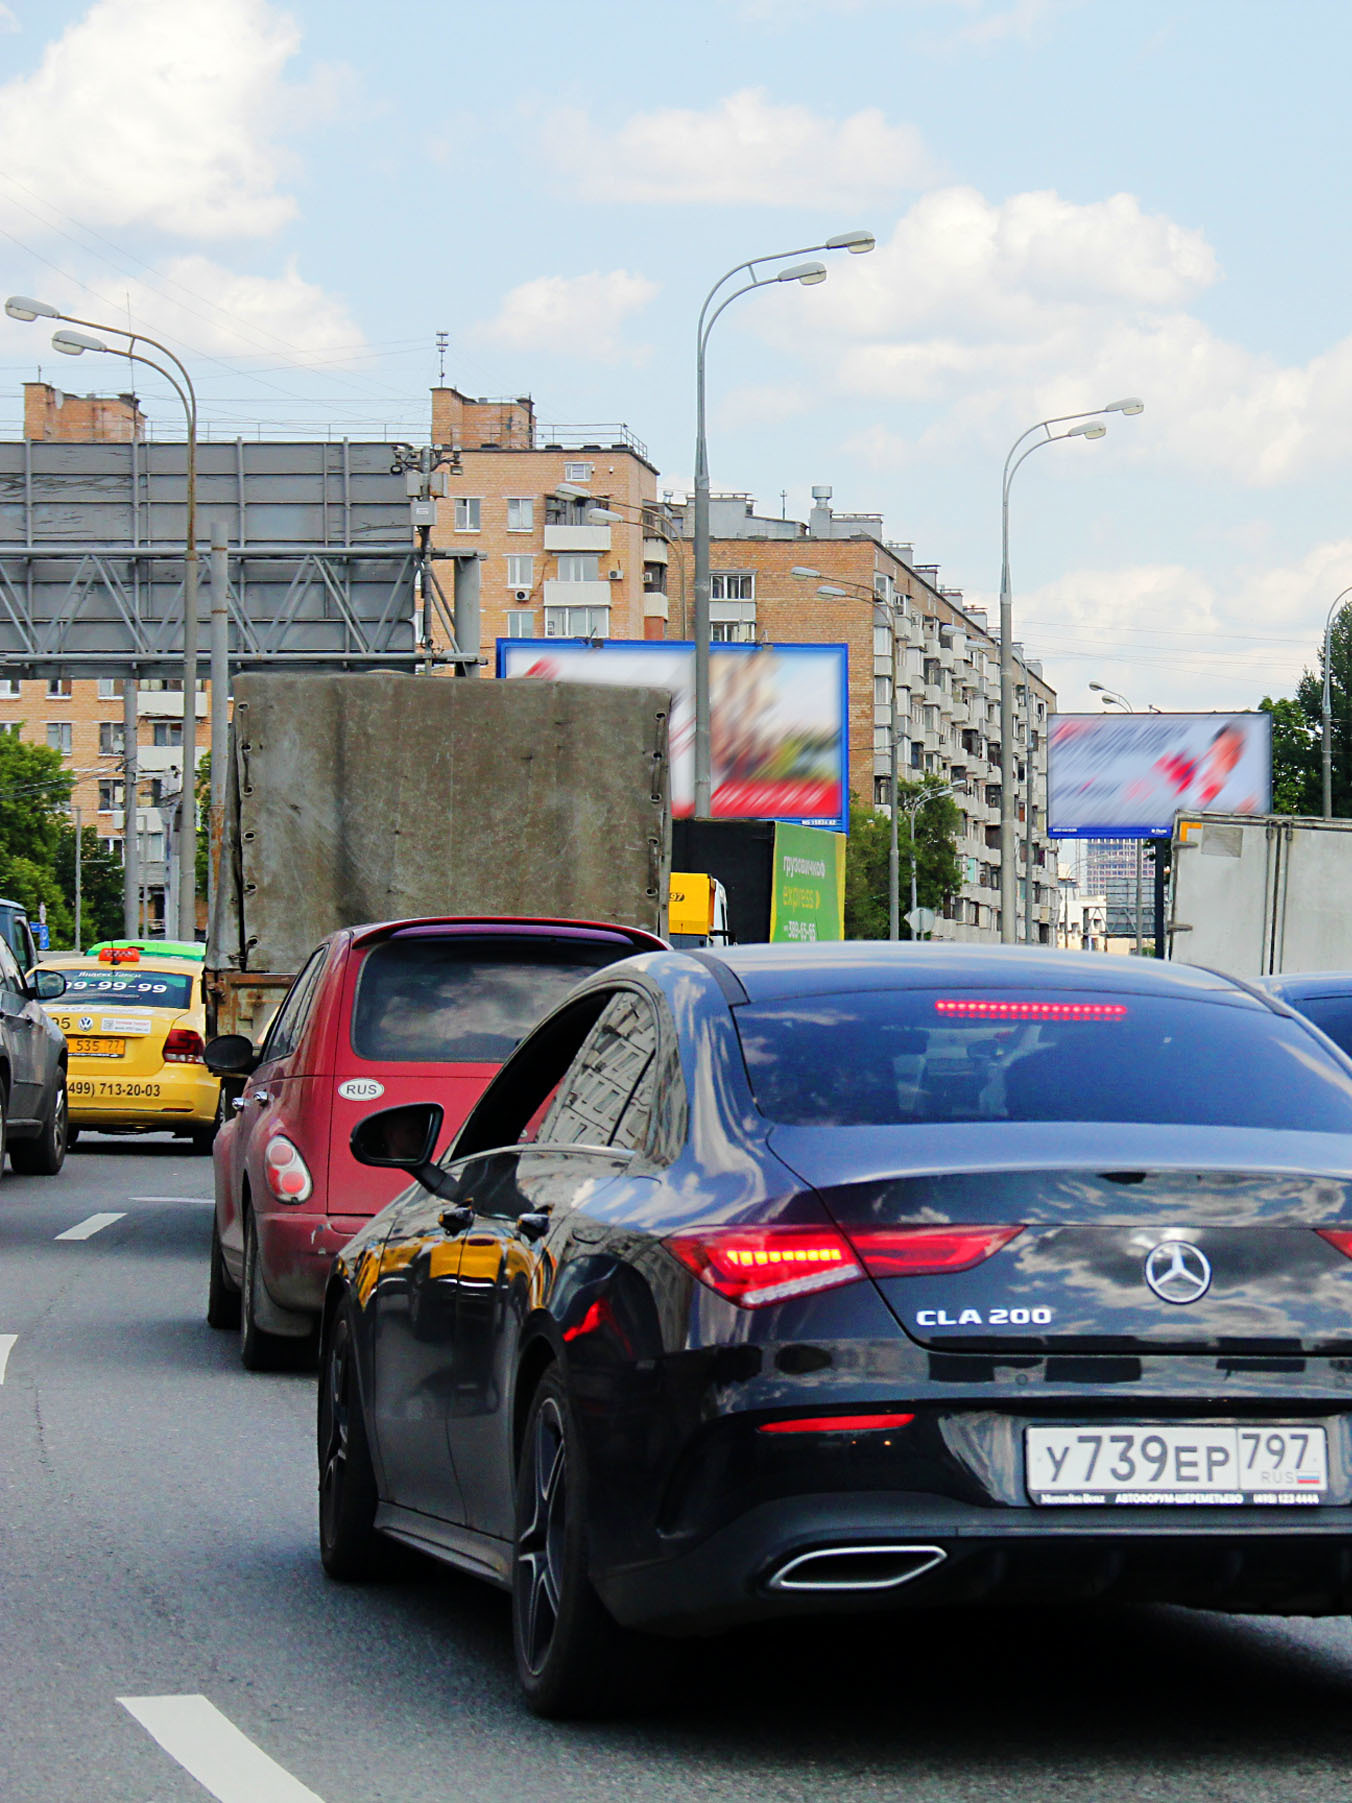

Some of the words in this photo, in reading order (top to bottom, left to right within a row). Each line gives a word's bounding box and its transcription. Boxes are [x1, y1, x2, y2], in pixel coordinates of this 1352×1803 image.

[68, 1082, 95, 1097] 499)
[100, 1083, 160, 1096] 713-20-03
[346, 1083, 378, 1096] RUS
[916, 1308, 982, 1326] CLA
[988, 1308, 1052, 1325] 200
[1242, 1433, 1310, 1470] 797
[1261, 1471, 1296, 1484] RUS
